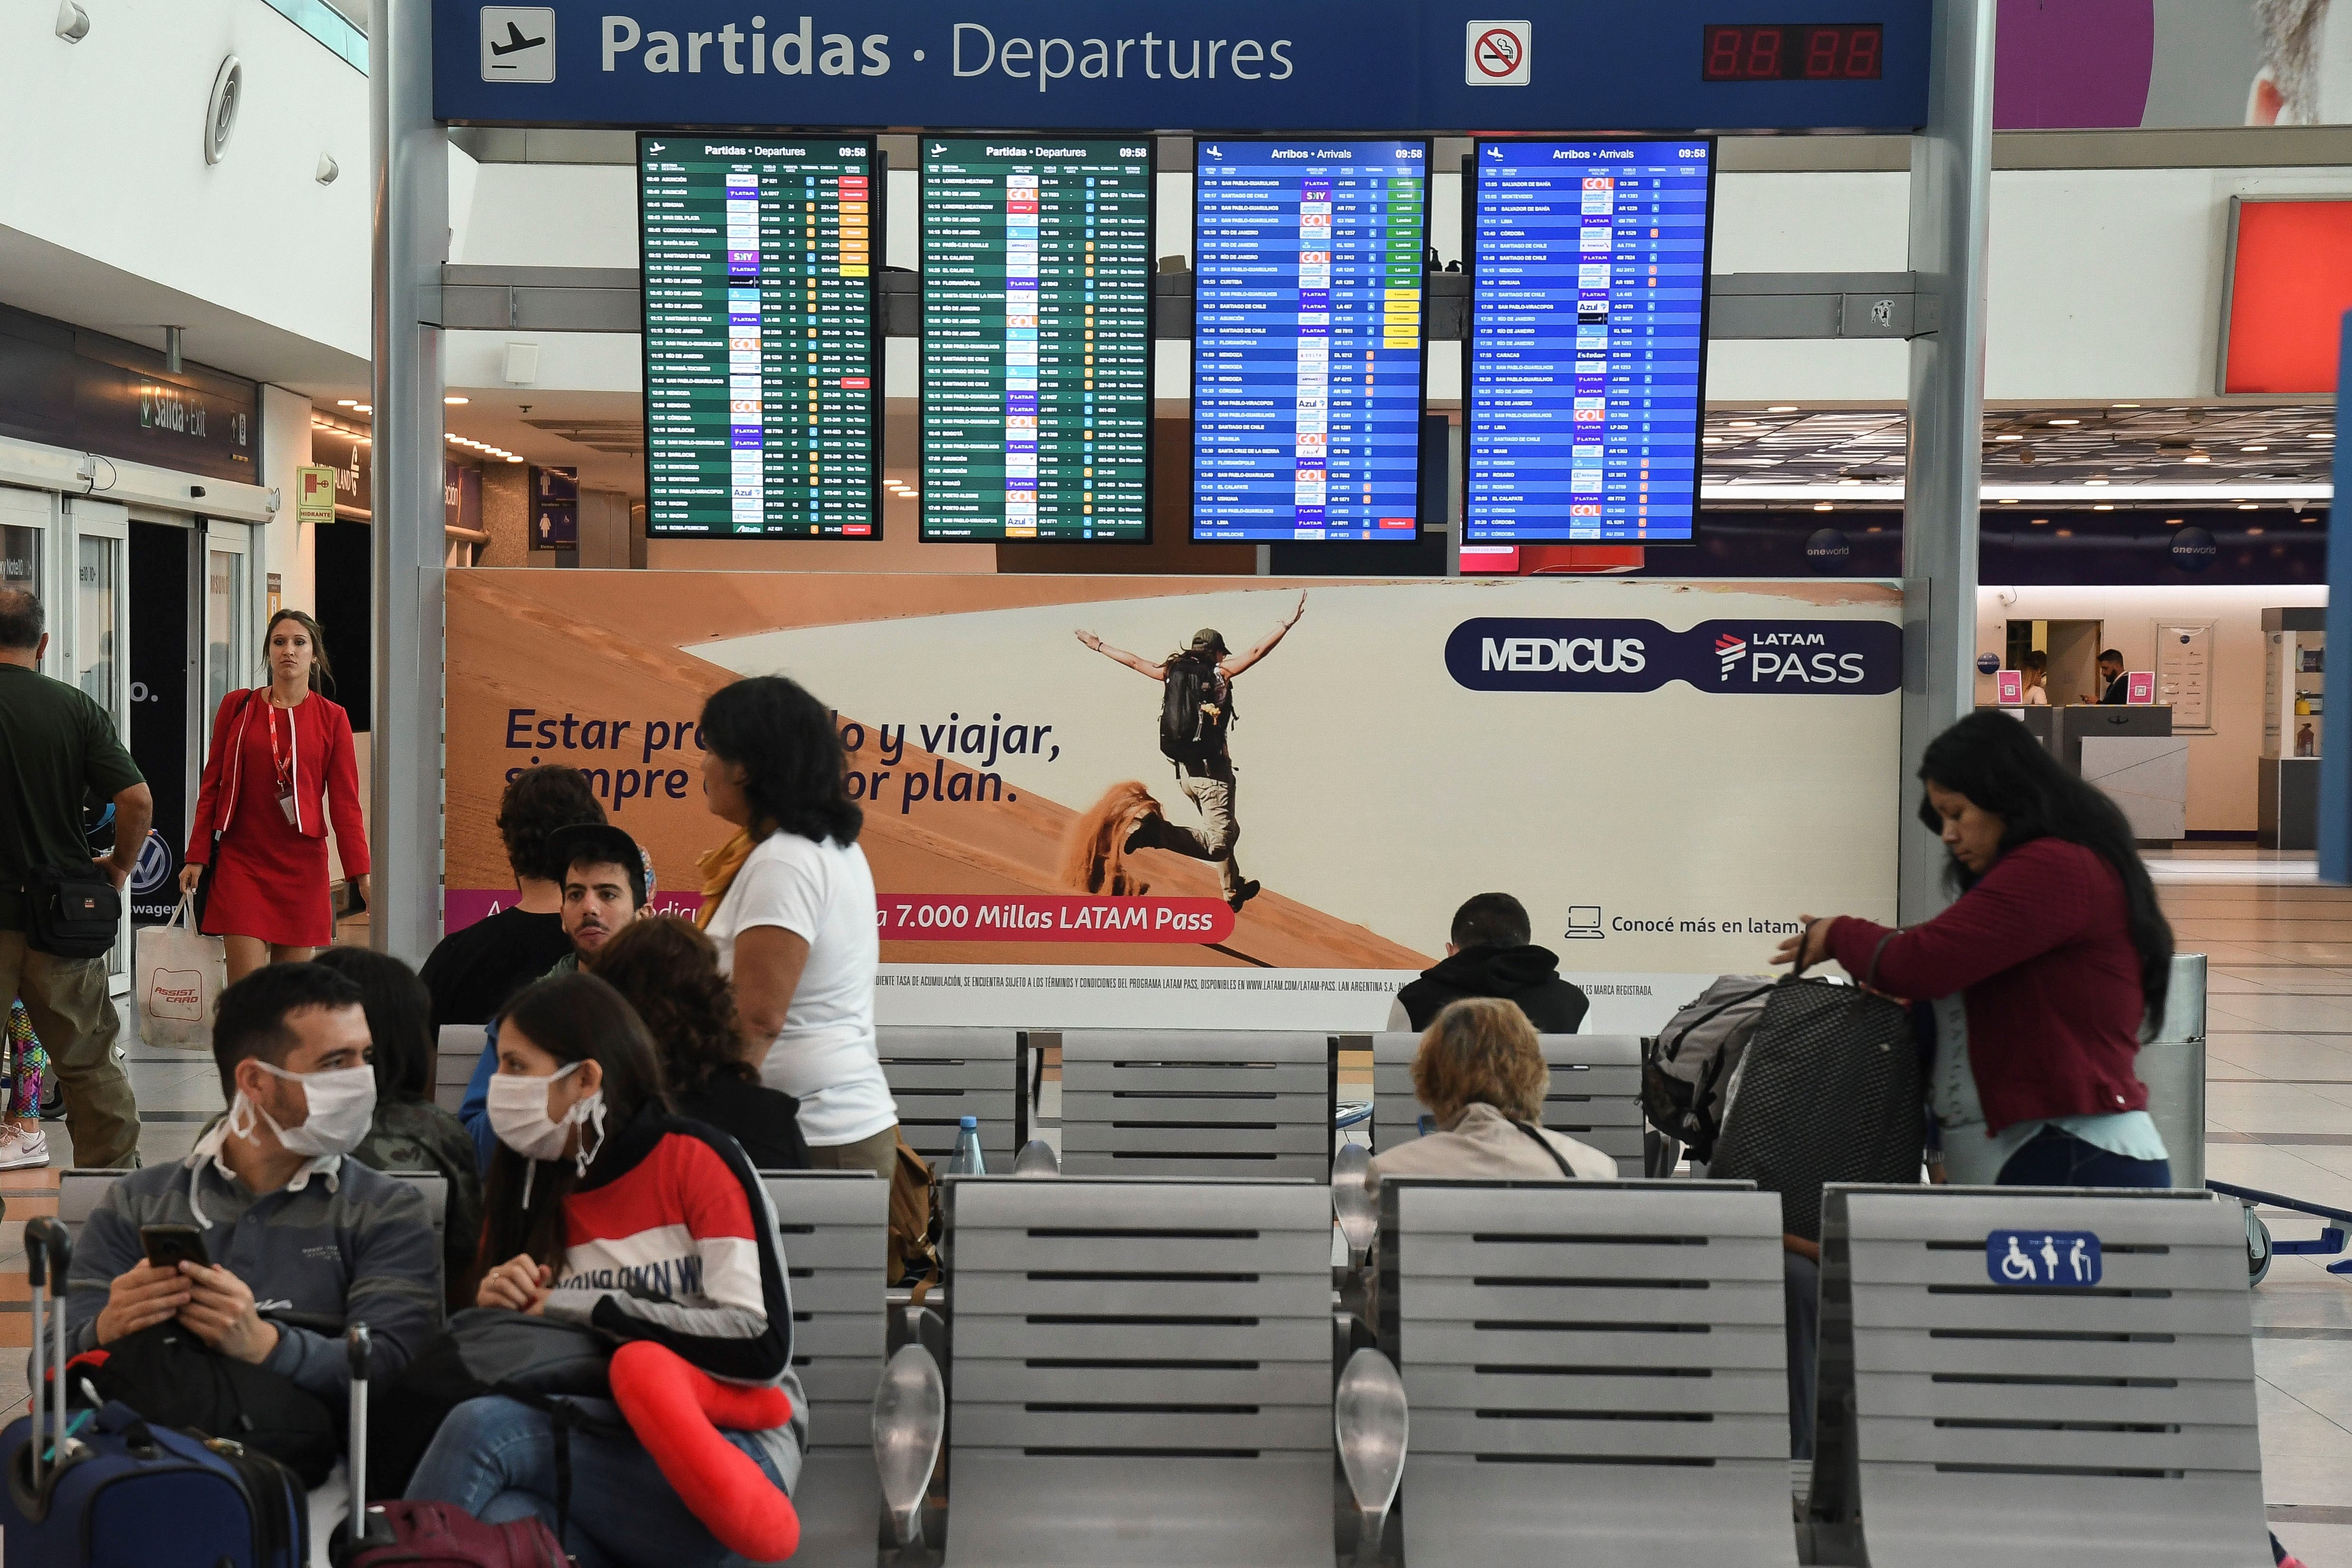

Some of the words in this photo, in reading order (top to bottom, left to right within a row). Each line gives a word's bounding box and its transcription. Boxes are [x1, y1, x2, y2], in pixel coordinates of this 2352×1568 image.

[602, 16, 890, 75] Partidas
[954, 23, 1293, 92] Departures
[705, 146, 746, 155] Partidas
[755, 147, 806, 158] Departures
[839, 148, 866, 157] 09:58
[986, 147, 1027, 156] Partidas
[1036, 147, 1086, 158] Departures
[1120, 148, 1146, 157] 09:58
[1272, 149, 1308, 158] Arribos
[1317, 150, 1351, 158] Arrivals
[1396, 149, 1422, 158] 09:58
[1553, 150, 1590, 159] Arribos
[1599, 150, 1634, 158] Arrivals
[1679, 149, 1705, 158] 09:58
[1584, 178, 1613, 189] GOL
[1009, 189, 1038, 200] GOL
[1302, 215, 1331, 226] GOL
[731, 339, 760, 350] GOL
[155, 386, 184, 432] Salida
[191, 398, 206, 438] Exit
[1008, 491, 1036, 502] GOL
[1807, 547, 1849, 555] oneworld
[2173, 546, 2216, 554] oneworld
[1754, 634, 1824, 645] LATAM
[1482, 638, 1645, 672] MEDICUS
[1752, 653, 1864, 683] PASS
[505, 708, 631, 749] Estar
[880, 724, 906, 766] y
[920, 712, 1060, 767] viajar,
[901, 759, 1017, 814] plan.
[896, 905, 969, 928] 7.000
[975, 905, 1053, 929] Millas
[1060, 906, 1148, 930] LATAM
[1155, 909, 1213, 932] Pass
[1612, 917, 1674, 932] Conocé
[1680, 917, 1715, 932] más
[1722, 922, 1742, 933] en
[896, 976, 911, 986] TASA
[912, 976, 919, 987] DE
[920, 975, 963, 988] ACUMULACIÓN,
[964, 977, 971, 987] SE
[972, 977, 1004, 987] ENCUENTRA
[1005, 977, 1026, 988] SUJETO
[1027, 977, 1032, 988] A
[1033, 977, 1044, 988] LOS
[1045, 977, 1074, 988] TÉRMINOS
[1075, 978, 1078, 988] Y
[1079, 978, 1116, 989] CONDICIONES
[1117, 978, 1128, 989] DEL
[1129, 979, 1162, 989] PROGRAMA
[1162, 979, 1182, 989] LATAM
[1183, 979, 1199, 990] PASS,
[1200, 980, 1237, 990] DISPONIBLES
[1237, 980, 1245, 990] EN
[1246, 980, 1337, 990] WWW.LATAM.COM/LATAM-PASS.
[1338, 981, 1349, 991] LAN
[1350, 981, 1383, 991] ARGENTINA
[1586, 985, 1593, 995] ES
[1594, 985, 1614, 995] MARCA
[1616, 985, 1653, 996] REGISTRADA.
[155, 987, 196, 996] ASSIST
